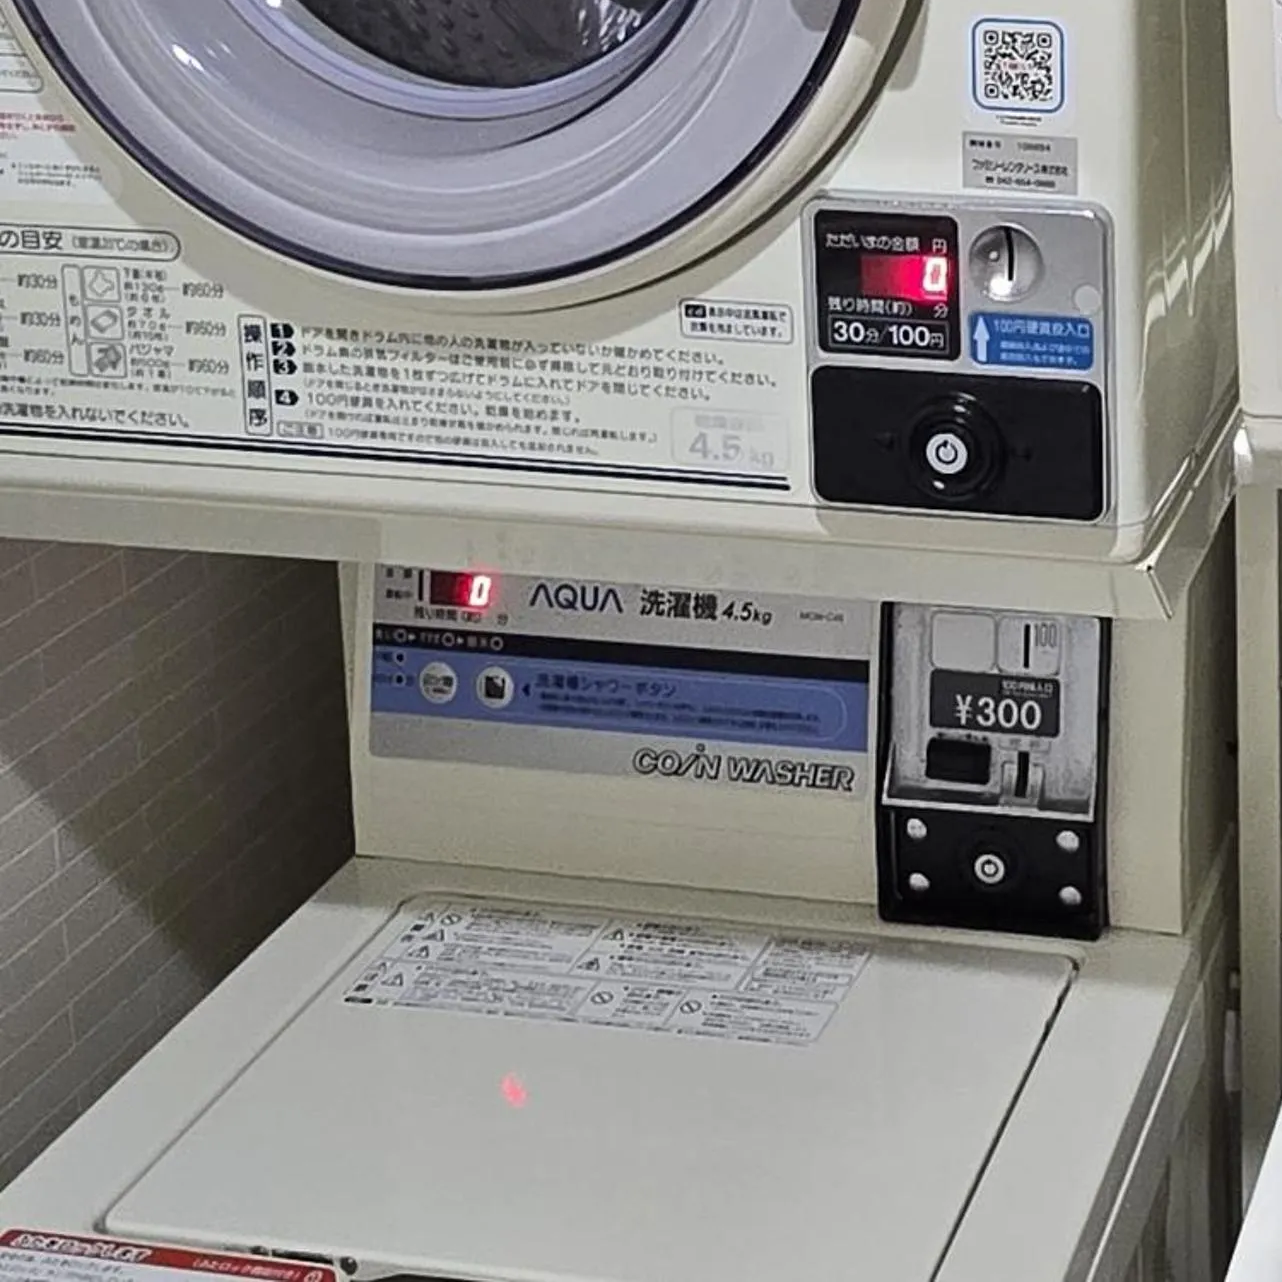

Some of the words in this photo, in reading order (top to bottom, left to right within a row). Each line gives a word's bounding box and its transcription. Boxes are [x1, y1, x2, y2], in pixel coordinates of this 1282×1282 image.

[922, 256, 948, 292] 0
[934, 302, 949, 319] 分
[469, 575, 492, 606] 0
[529, 582, 624, 614] AQUA
[640, 588, 718, 621] 洗濯機
[721, 602, 772, 626] 4.5kg
[1033, 621, 1058, 648] 100
[955, 693, 1043, 730] ¥300
[726, 754, 855, 793] WASHER
